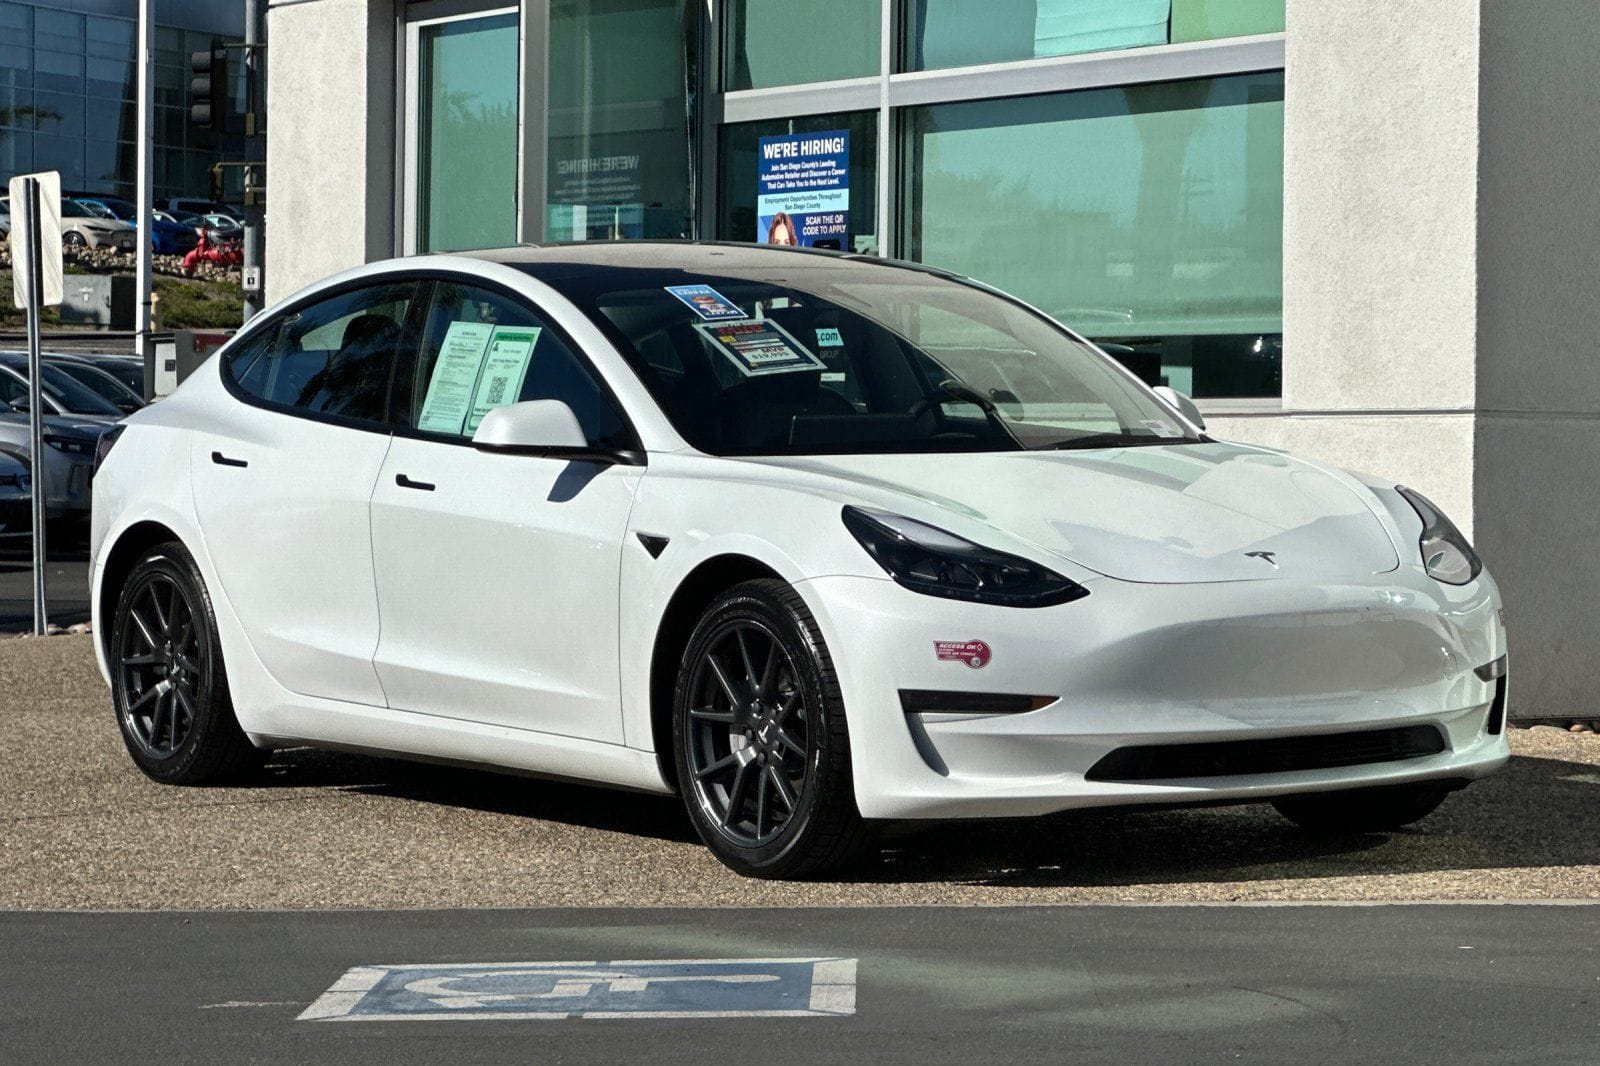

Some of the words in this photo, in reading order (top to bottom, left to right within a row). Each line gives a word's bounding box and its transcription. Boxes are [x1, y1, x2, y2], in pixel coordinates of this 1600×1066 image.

[764, 142, 798, 159] WE'RE
[800, 138, 844, 156] HIRING!
[788, 162, 800, 170] Diego
[801, 161, 819, 169] County's
[820, 160, 836, 168] Leading
[765, 196, 789, 204] Employment
[790, 195, 817, 203] Opportunities
[805, 216, 821, 225] SCAN
[822, 215, 834, 224] THE
[835, 214, 844, 224] QR
[803, 226, 819, 235] CODE
[820, 225, 828, 234] TO
[828, 224, 846, 234] APPLY
